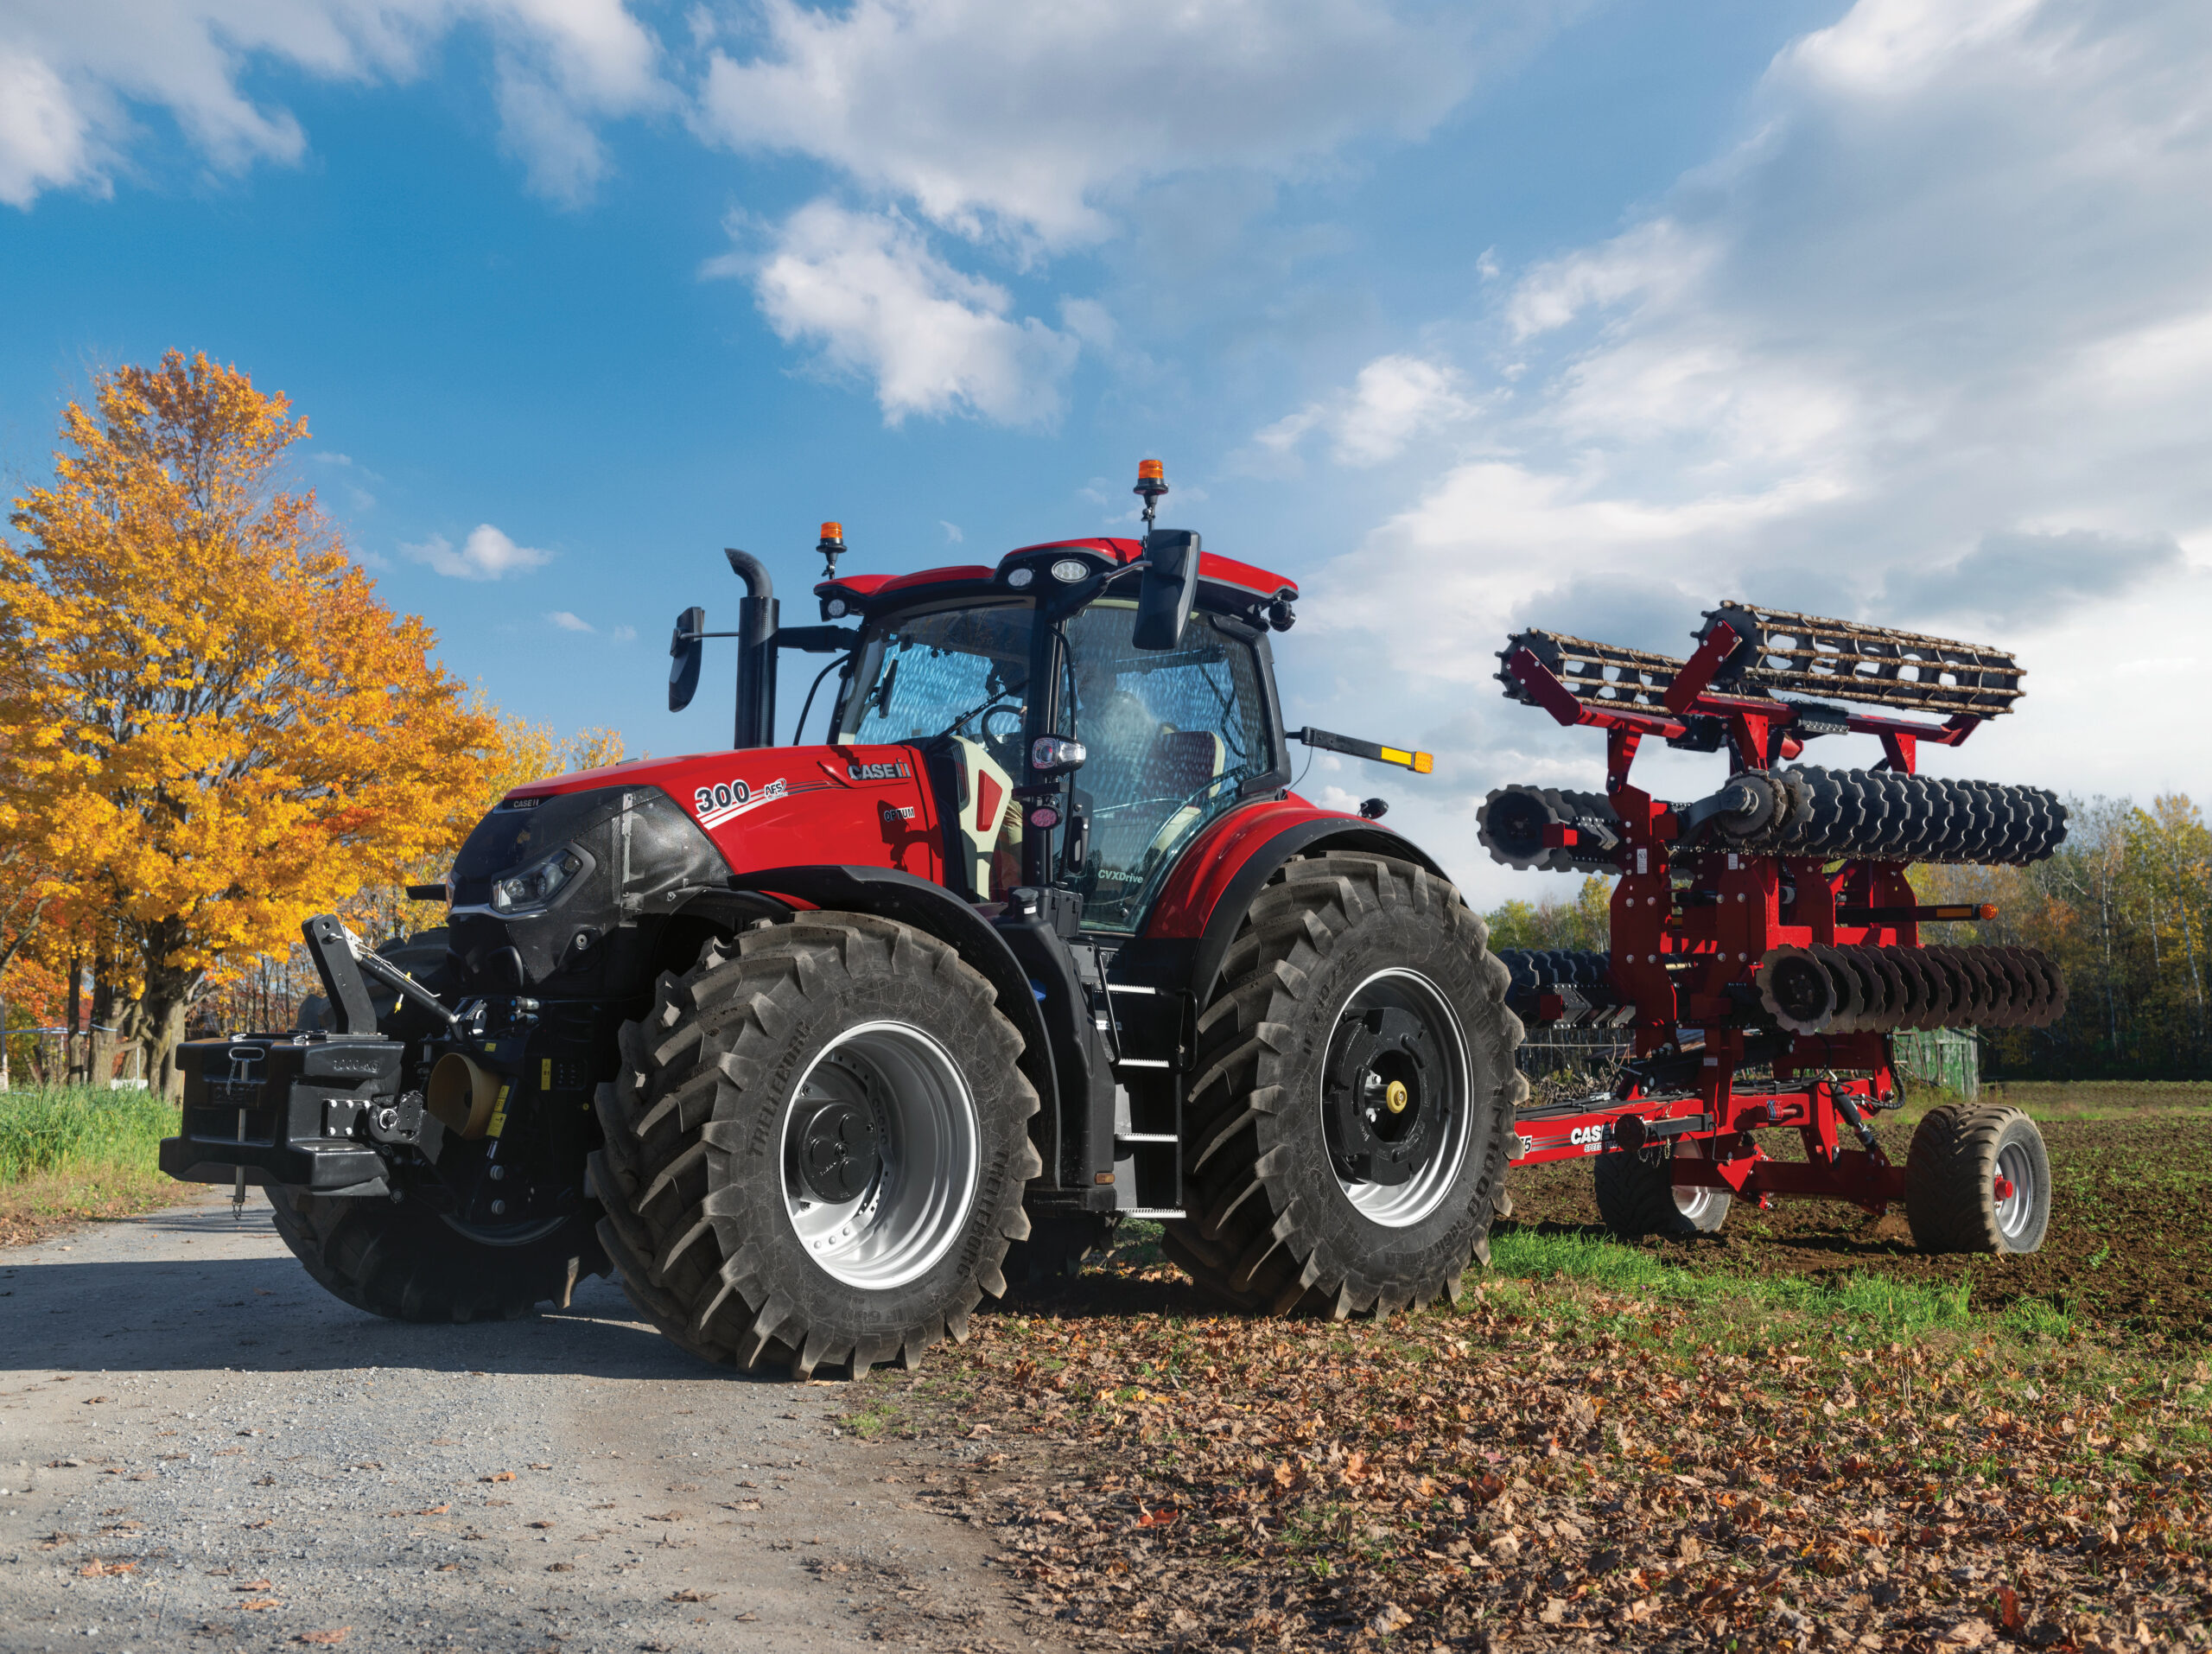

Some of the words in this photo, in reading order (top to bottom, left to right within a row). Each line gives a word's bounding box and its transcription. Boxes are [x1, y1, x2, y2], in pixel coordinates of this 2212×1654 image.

[848, 763, 896, 780] CASE
[695, 779, 751, 813] 300
[765, 780, 785, 796] AFS
[513, 798, 532, 808] CASE
[884, 806, 916, 822] OPTUM
[1097, 869, 1144, 884] CVXDrive
[749, 1020, 810, 1156] TRELLEBORG
[958, 1145, 1010, 1279] TRELLEBORG
